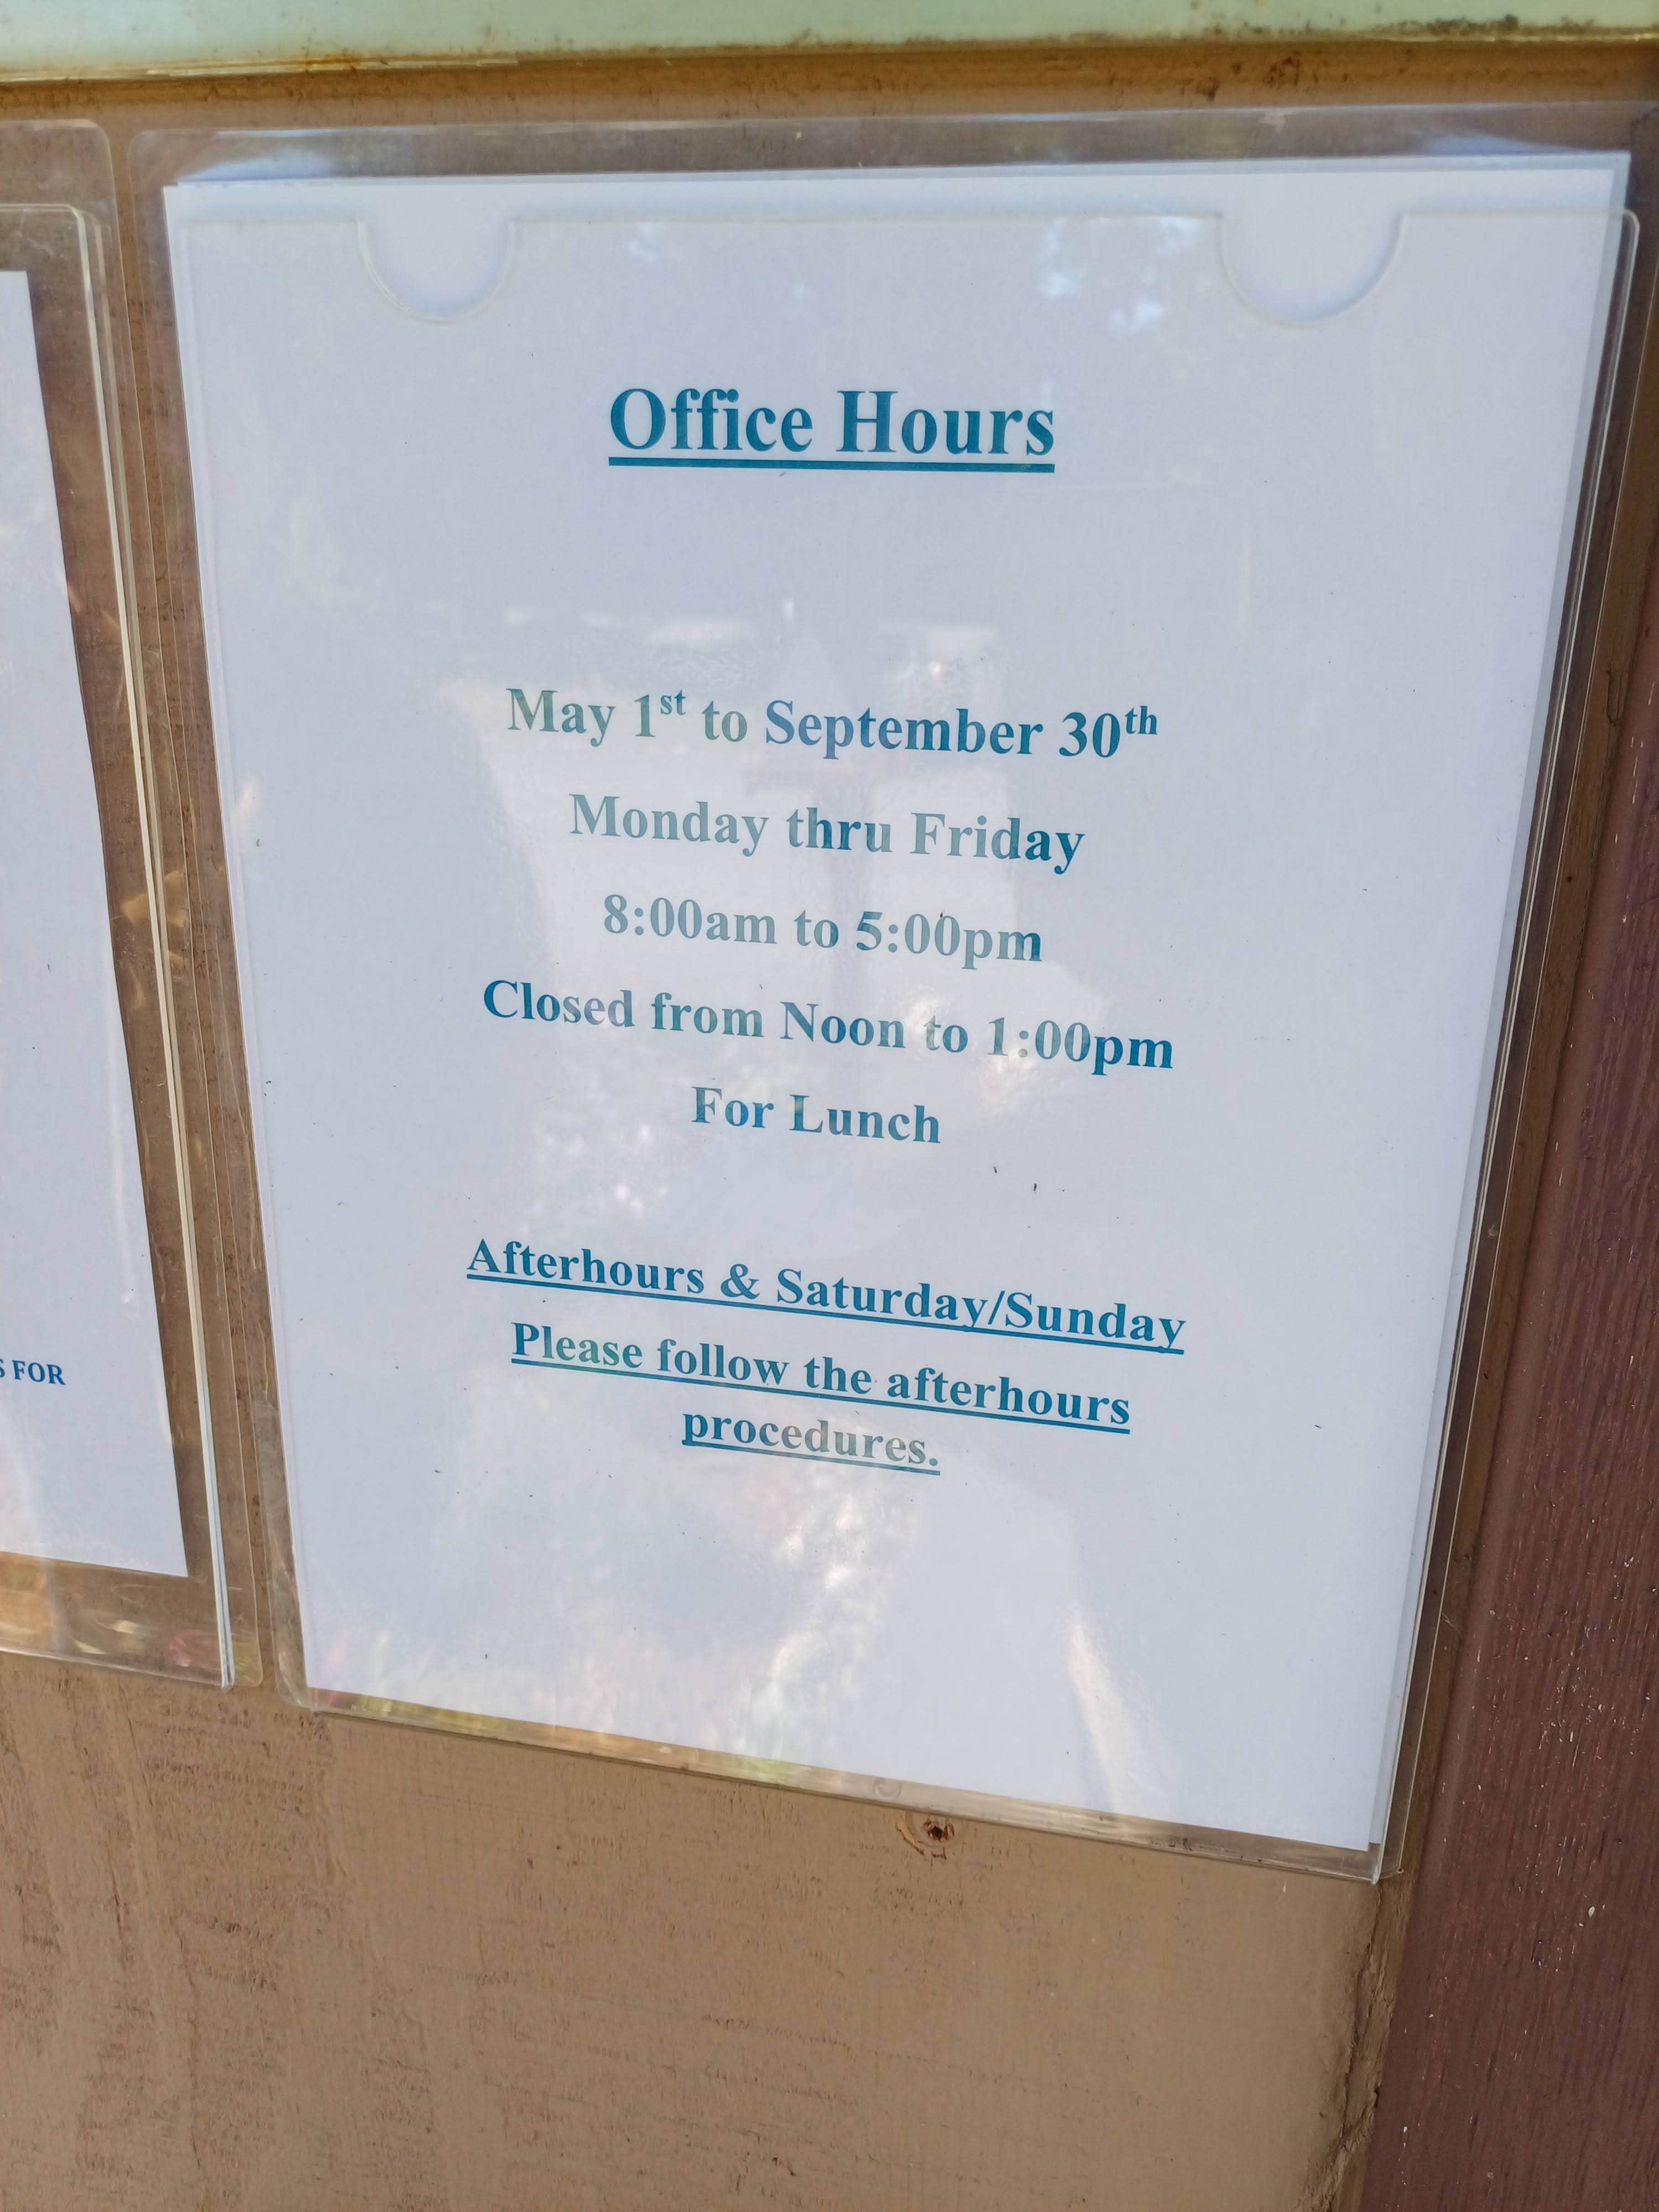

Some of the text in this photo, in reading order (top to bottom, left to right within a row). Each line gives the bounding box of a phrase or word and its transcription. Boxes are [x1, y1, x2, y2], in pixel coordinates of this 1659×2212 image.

[611, 388, 1054, 456] Office Hours
[506, 688, 1158, 759] May 1st to September 30th
[570, 794, 1085, 874] Monday thru Friday
[603, 894, 1042, 969] 8:00am to 5:00pm
[483, 979, 1173, 1075] Closed from Noon to 1:00pm
[692, 1086, 941, 1144] For Lunch
[467, 1239, 1186, 1350] Afterhours & Saturday/Sunday
[12, 1360, 66, 1385] FOR
[511, 1323, 1130, 1425] Please follow the afterhours
[682, 1413, 938, 1468] procedures.
